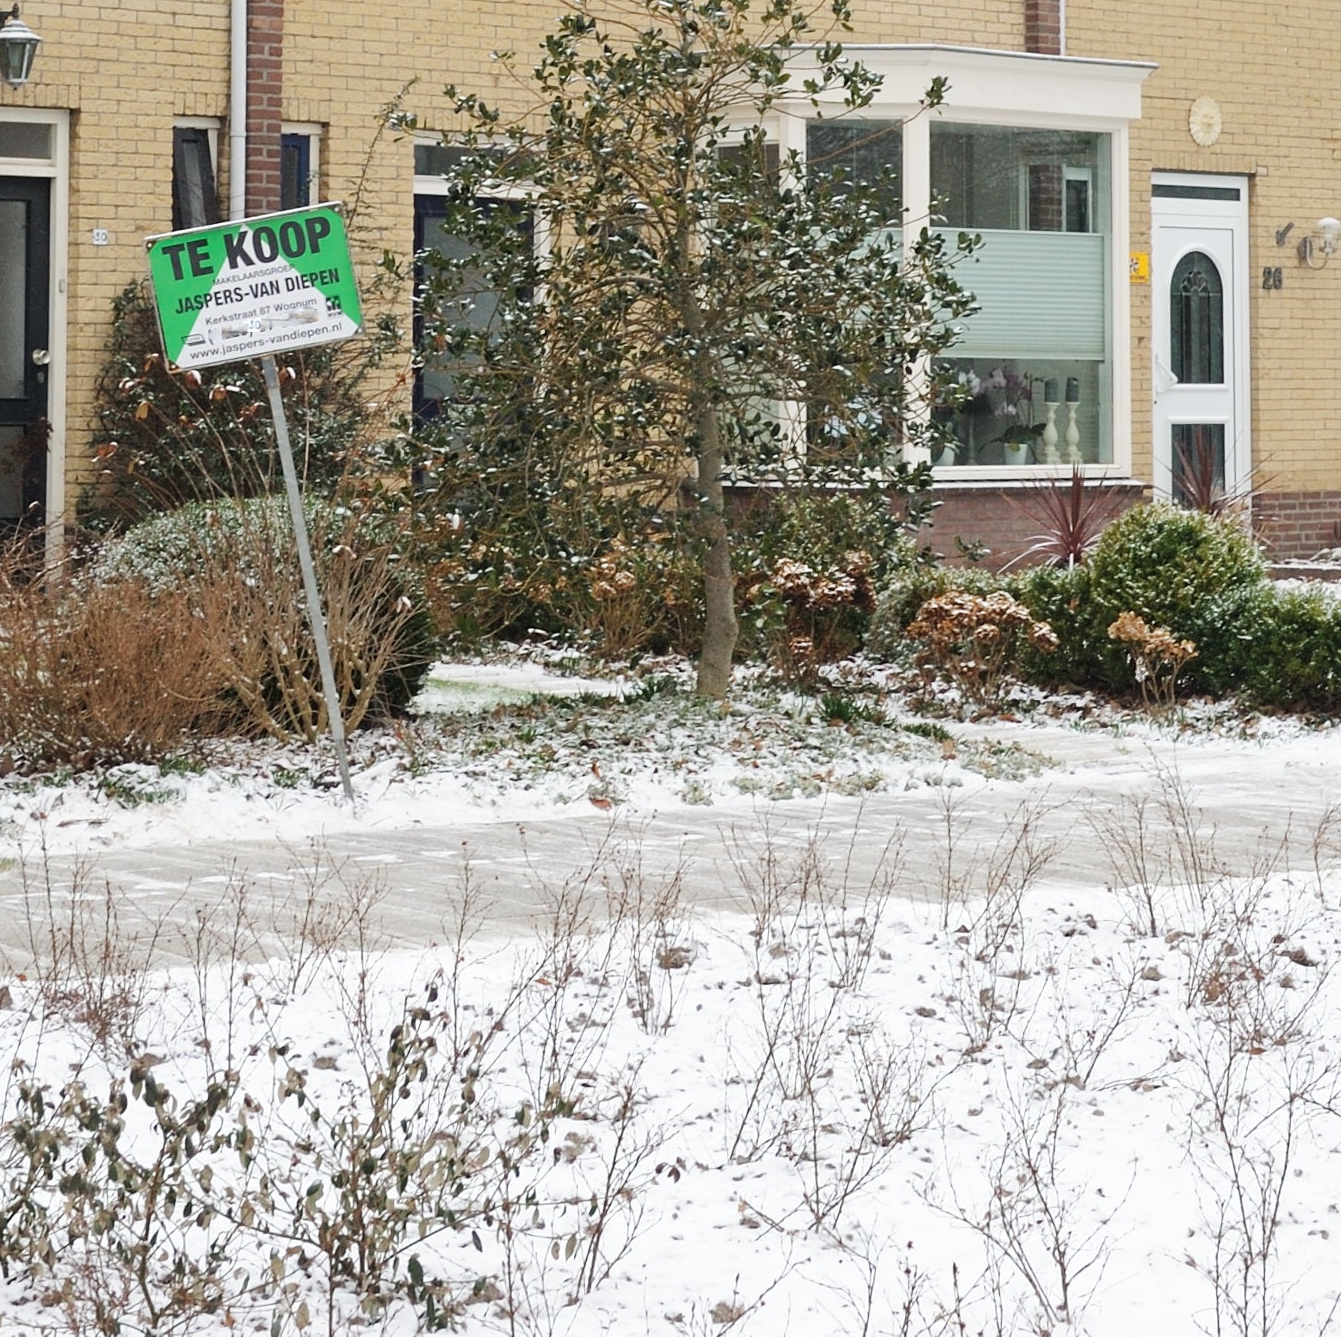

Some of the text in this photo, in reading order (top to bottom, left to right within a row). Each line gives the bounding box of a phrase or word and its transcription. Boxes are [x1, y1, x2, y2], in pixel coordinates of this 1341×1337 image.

[94, 232, 107, 242] 30
[162, 217, 331, 281] TE KOOP
[213, 264, 295, 285] MAKELAARSGROEP
[1262, 267, 1283, 290] 26
[175, 268, 340, 315] JASPERS-VAN DIEPEN
[205, 310, 257, 326] Kerkstraat
[189, 323, 343, 360] www.jaspers-vandiepen.nl
